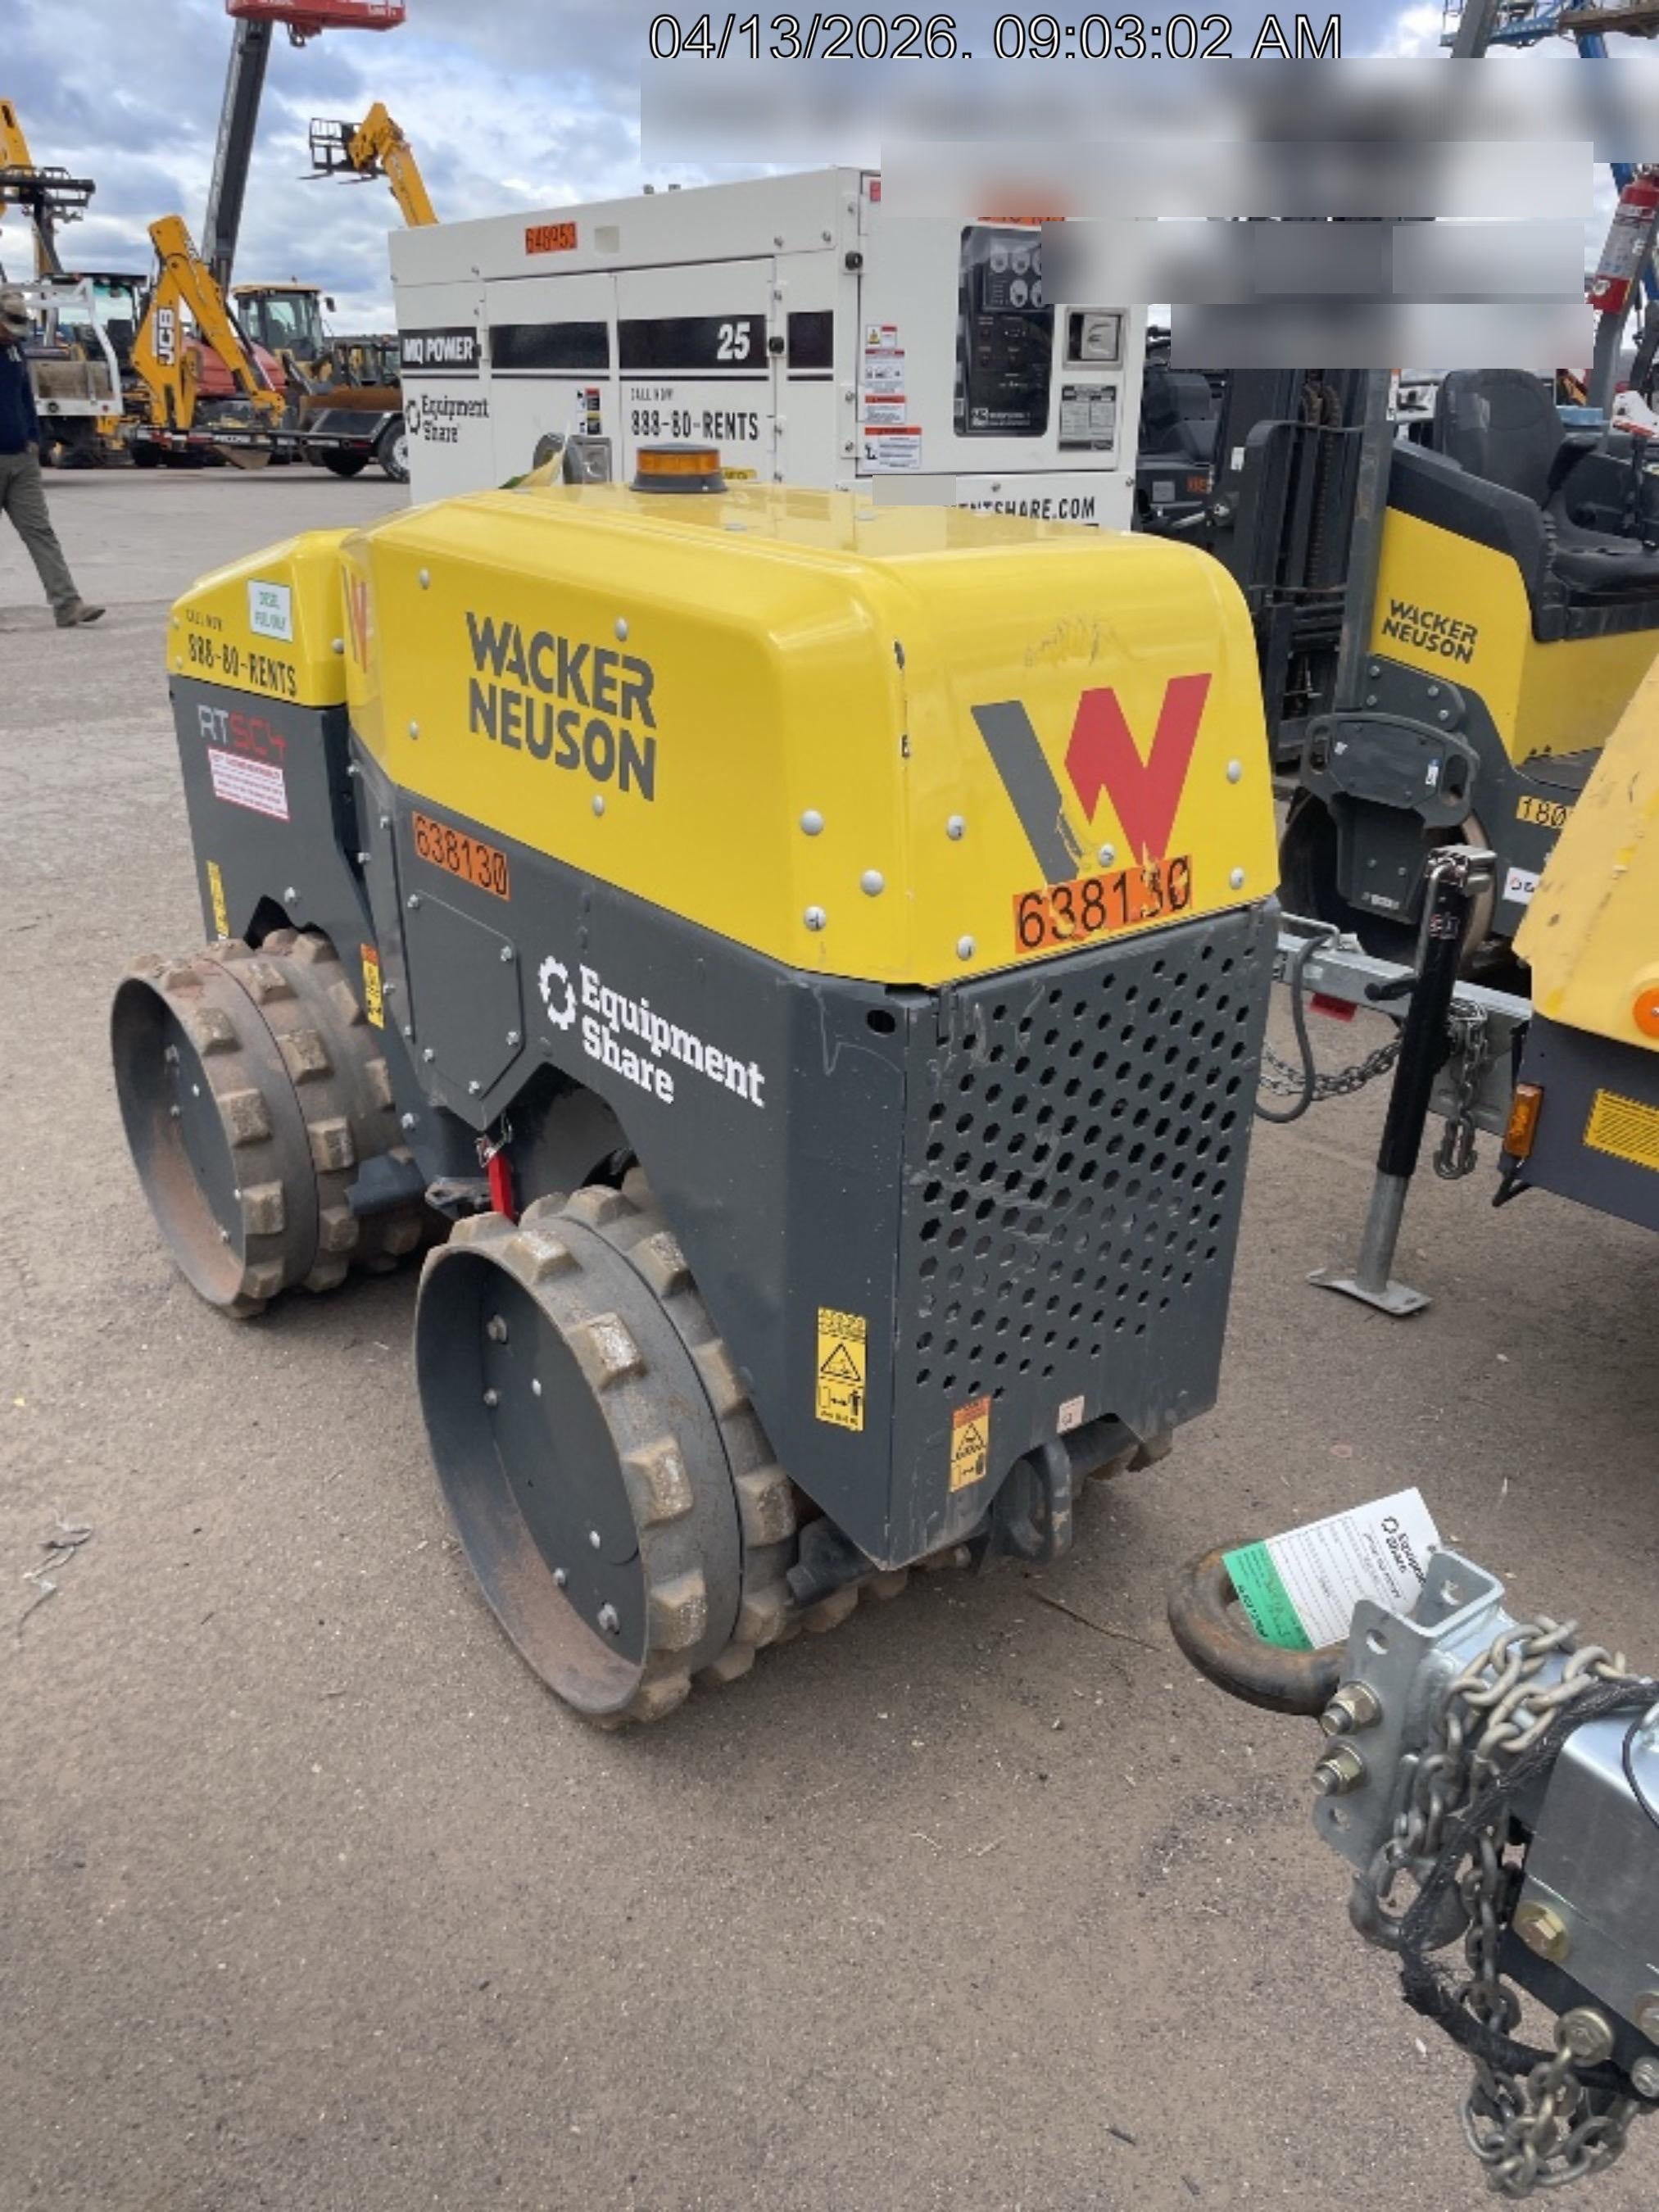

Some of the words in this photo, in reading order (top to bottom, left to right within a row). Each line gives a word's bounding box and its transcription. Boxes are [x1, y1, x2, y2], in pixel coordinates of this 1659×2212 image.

[158, 308, 175, 365] JCB
[403, 338, 424, 365] MQ
[426, 336, 473, 362] POWER
[717, 321, 751, 360] 25
[421, 394, 490, 420] Equipment
[424, 420, 459, 443] Share
[631, 410, 759, 441] 888-80-RENTS
[1380, 616, 1474, 664] NEUSON
[1390, 598, 1478, 645] WACKER
[188, 632, 297, 696] 888-80-RENTS
[465, 611, 657, 731] WACKER
[468, 677, 656, 804] NEUSON
[1522, 798, 1571, 827] 180
[416, 815, 507, 895] 638130
[1018, 857, 1190, 949] 638130
[579, 963, 765, 1108] Equipment
[582, 1014, 675, 1104] Share
